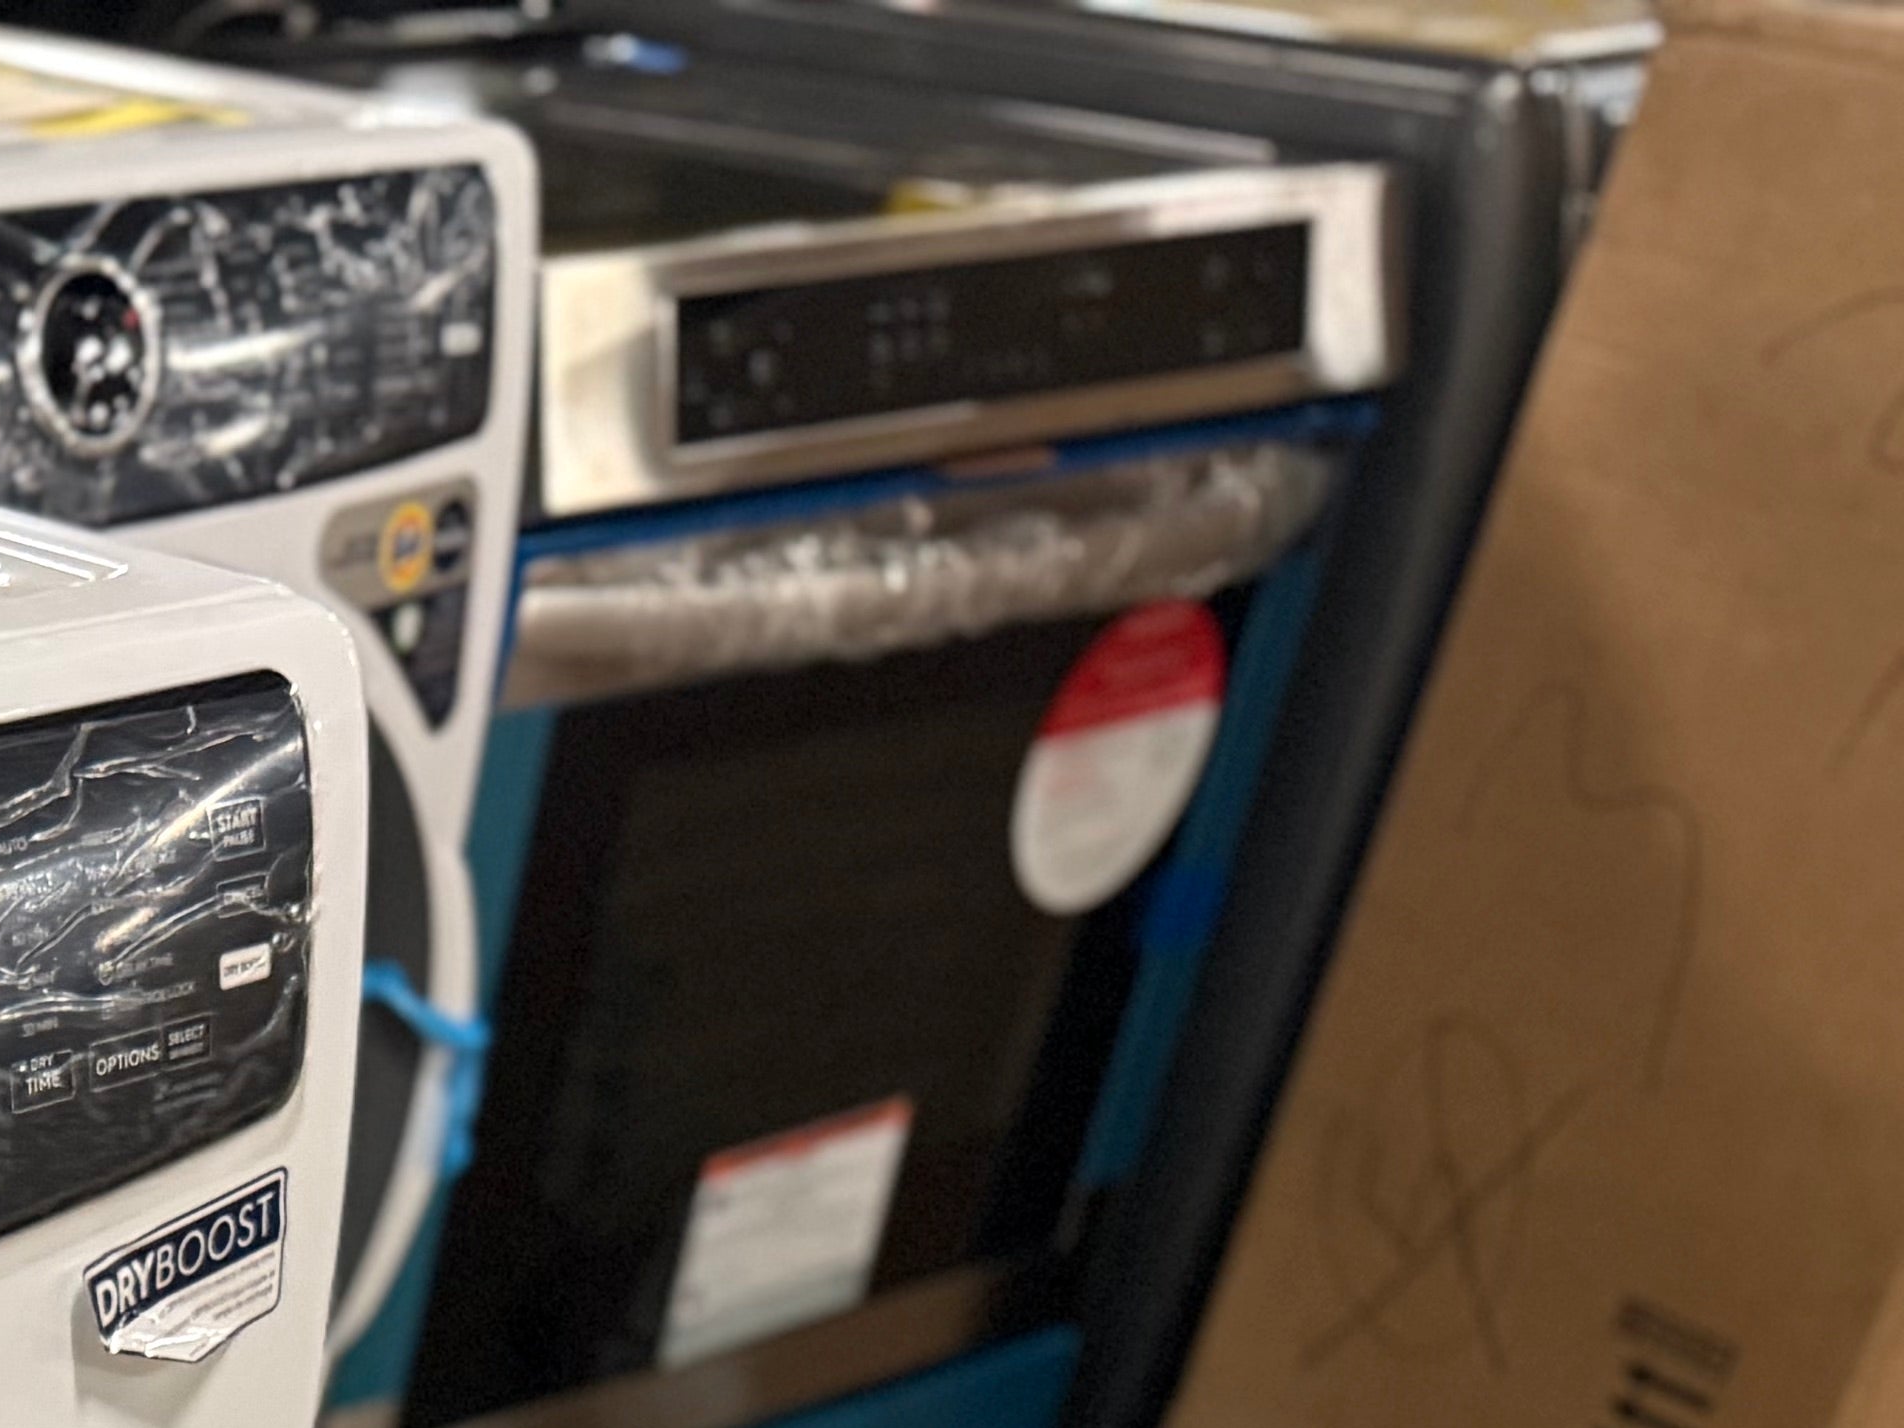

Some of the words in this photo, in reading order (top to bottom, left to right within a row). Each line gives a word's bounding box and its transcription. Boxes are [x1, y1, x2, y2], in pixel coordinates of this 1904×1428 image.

[216, 806, 258, 834] START
[30, 1053, 54, 1073] DRY
[95, 1045, 161, 1077] OPTIONS
[24, 1073, 61, 1097] TIME
[95, 1191, 277, 1330] DRYBOOST
